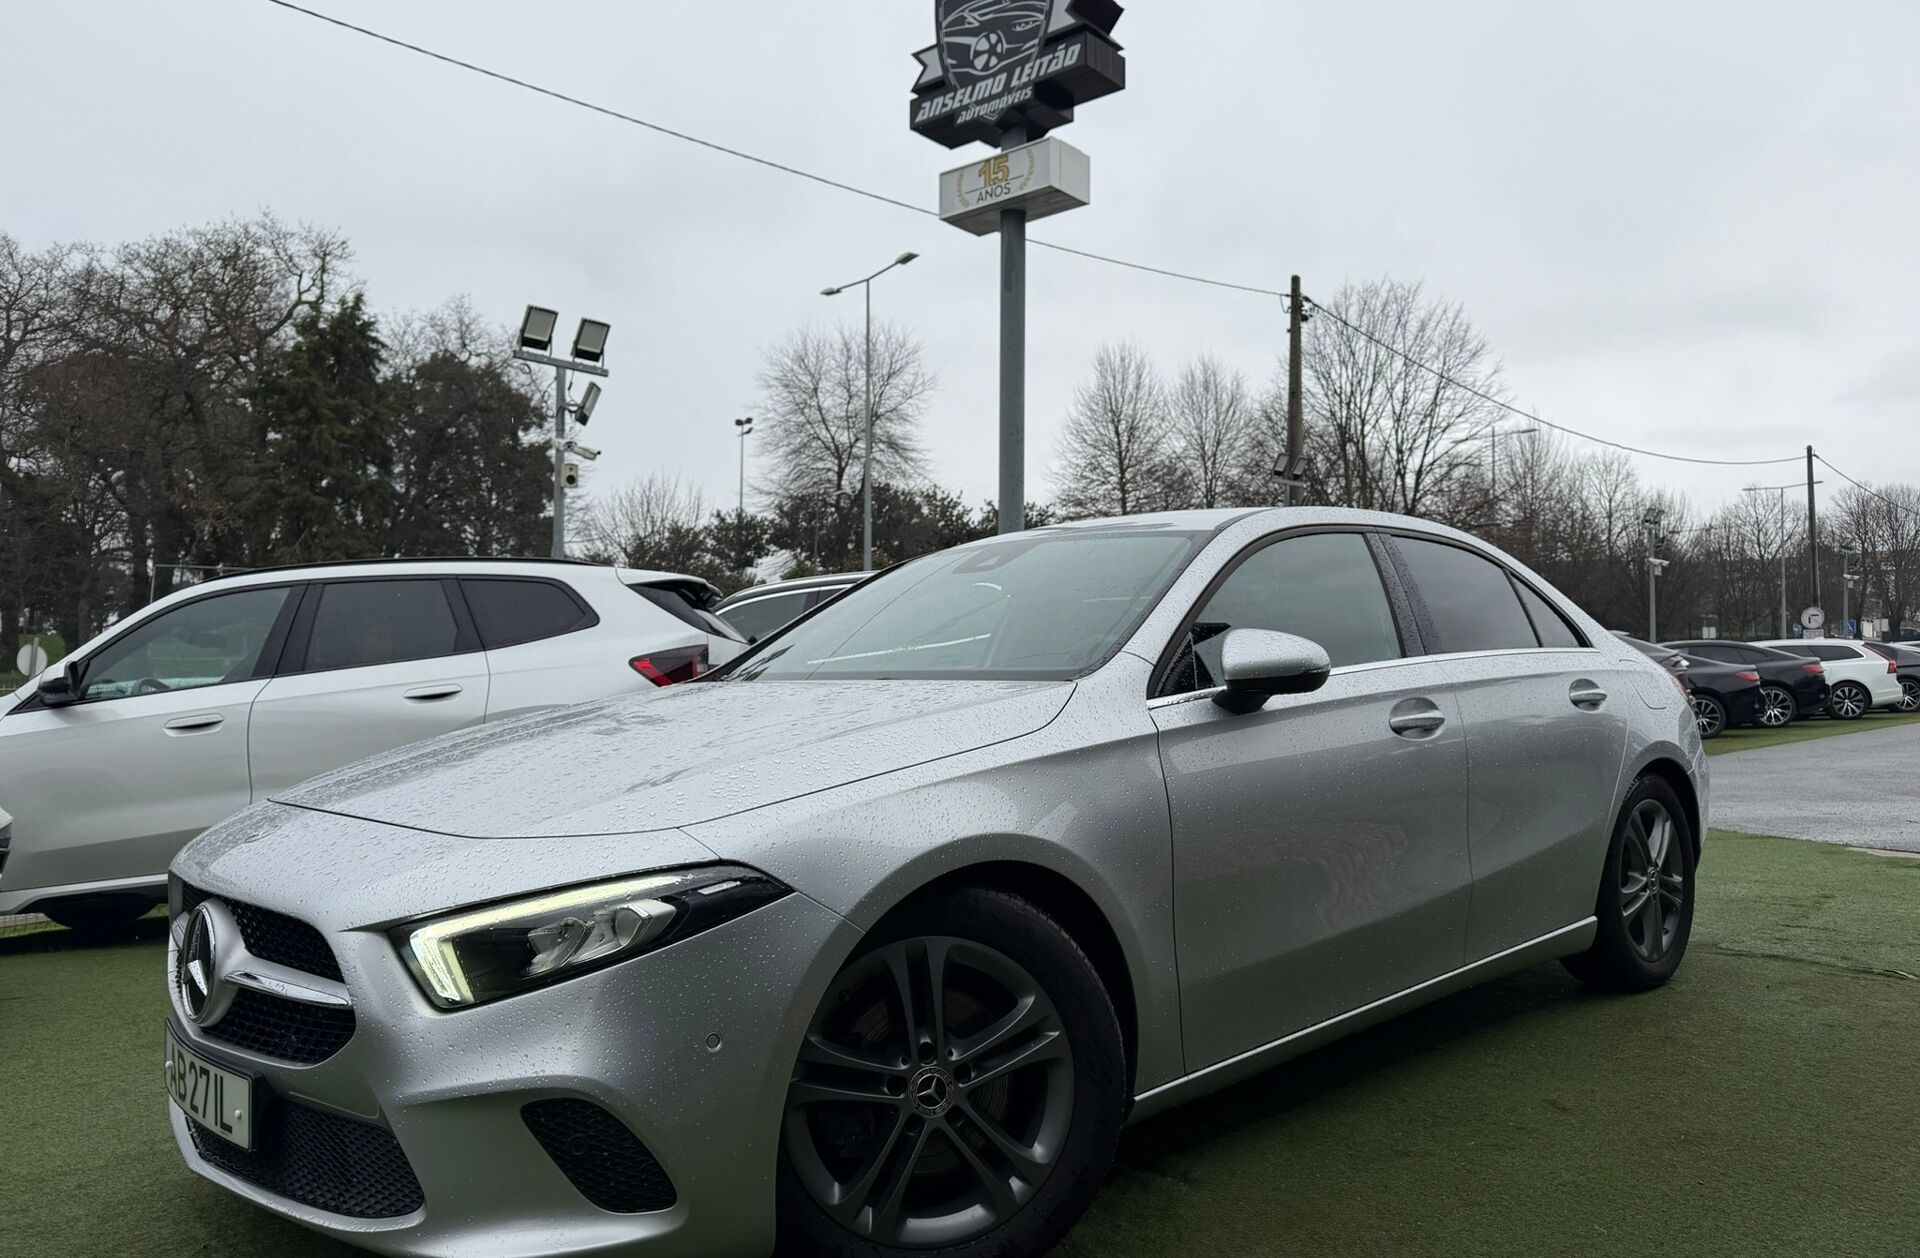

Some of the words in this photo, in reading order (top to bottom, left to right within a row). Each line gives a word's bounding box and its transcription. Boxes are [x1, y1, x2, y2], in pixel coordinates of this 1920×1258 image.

[915, 74, 1006, 123] ANSELMO
[1010, 44, 1081, 87] LEITÃO
[979, 155, 1009, 187] 15
[976, 183, 1011, 202] ANOS
